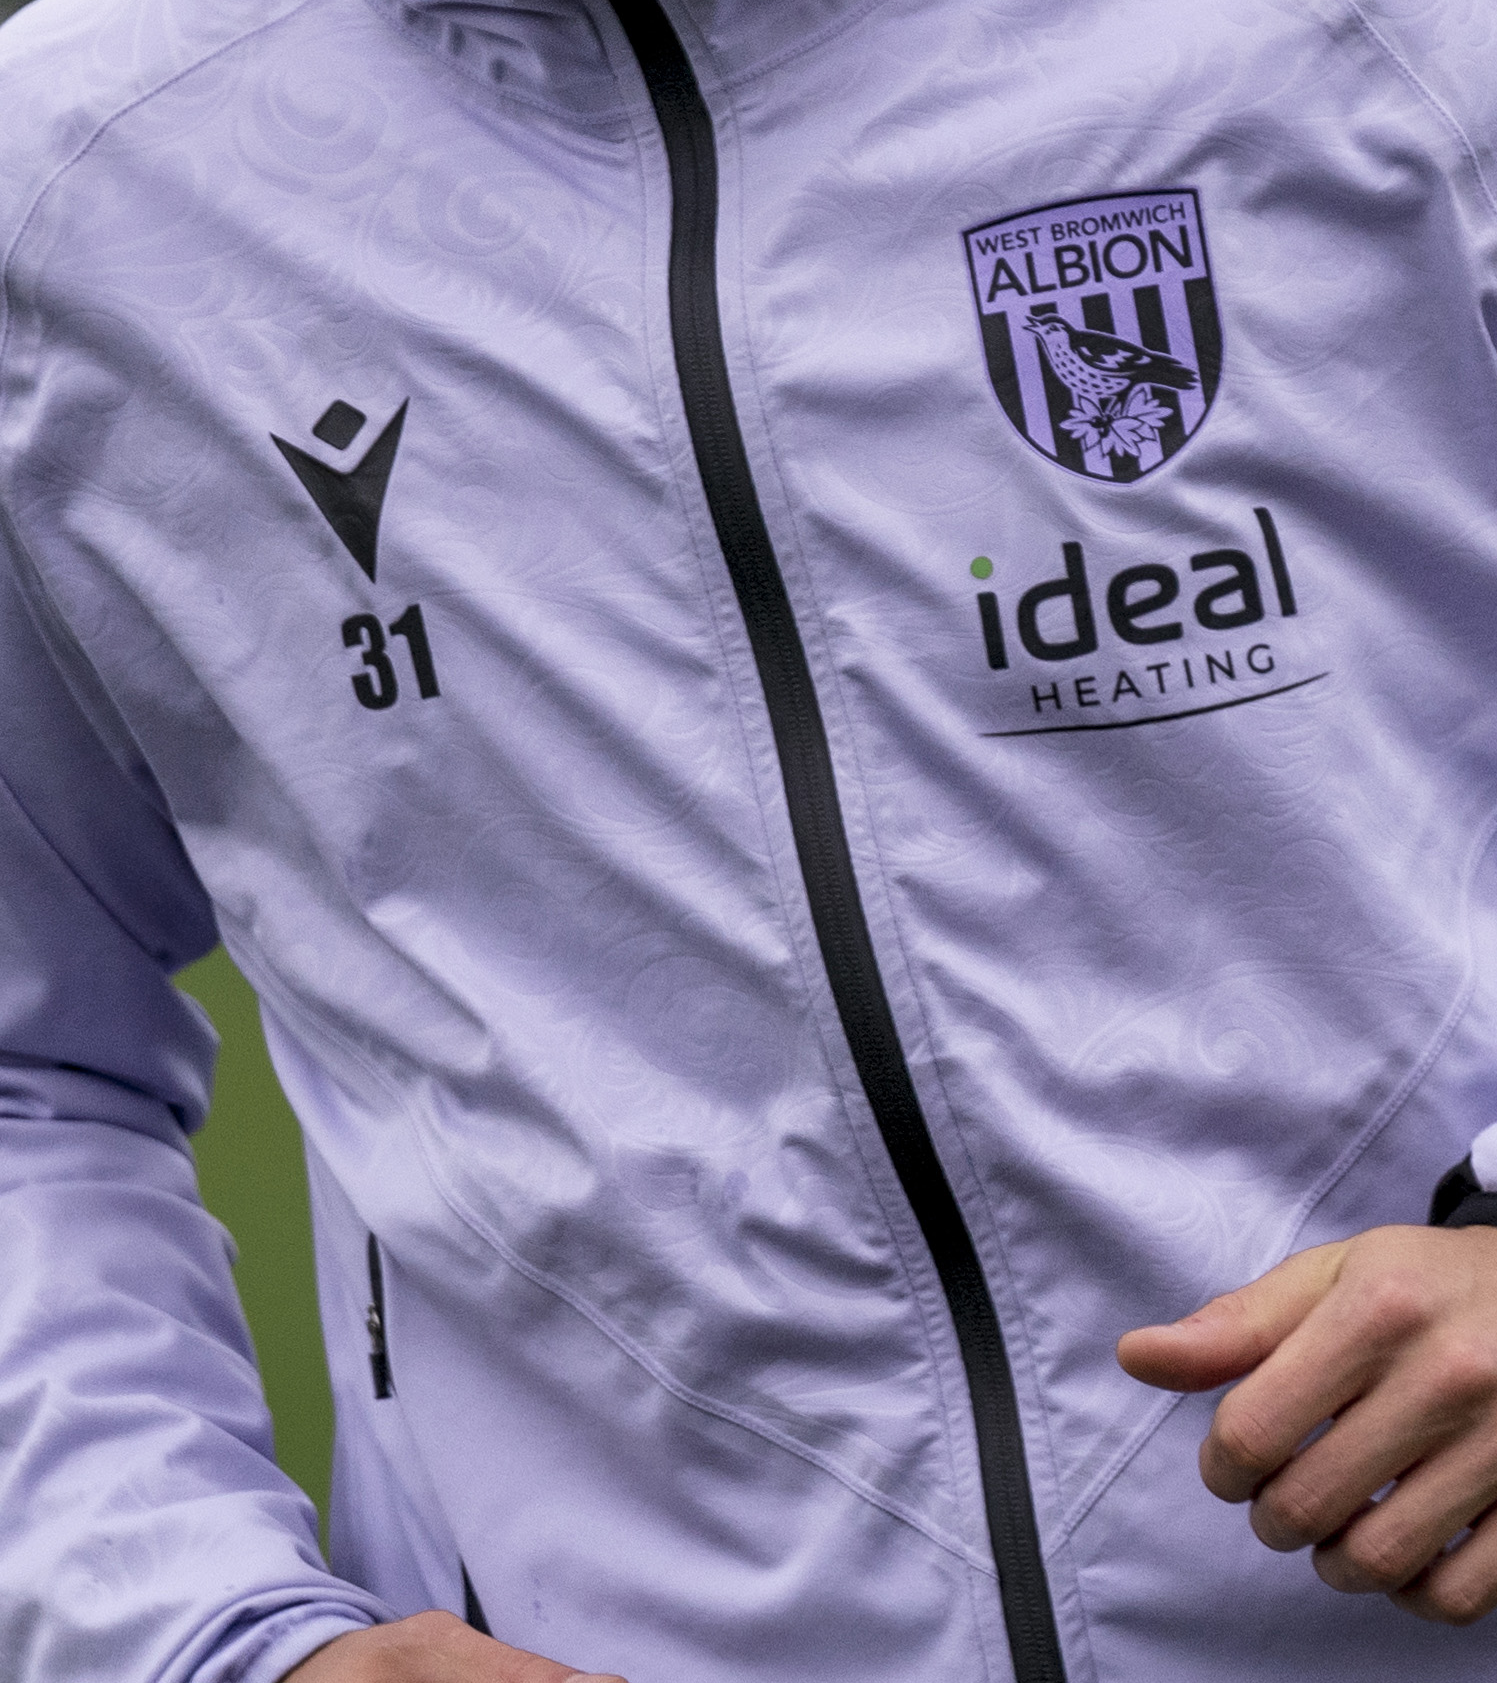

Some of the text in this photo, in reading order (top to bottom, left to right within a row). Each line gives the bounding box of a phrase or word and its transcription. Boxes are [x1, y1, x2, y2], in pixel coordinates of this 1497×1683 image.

[976, 202, 1186, 256] WEST BROMWICH
[988, 225, 1193, 303] ALBION
[970, 506, 1298, 671] ideal
[340, 603, 441, 711] 31
[1031, 643, 1276, 713] HEATING
